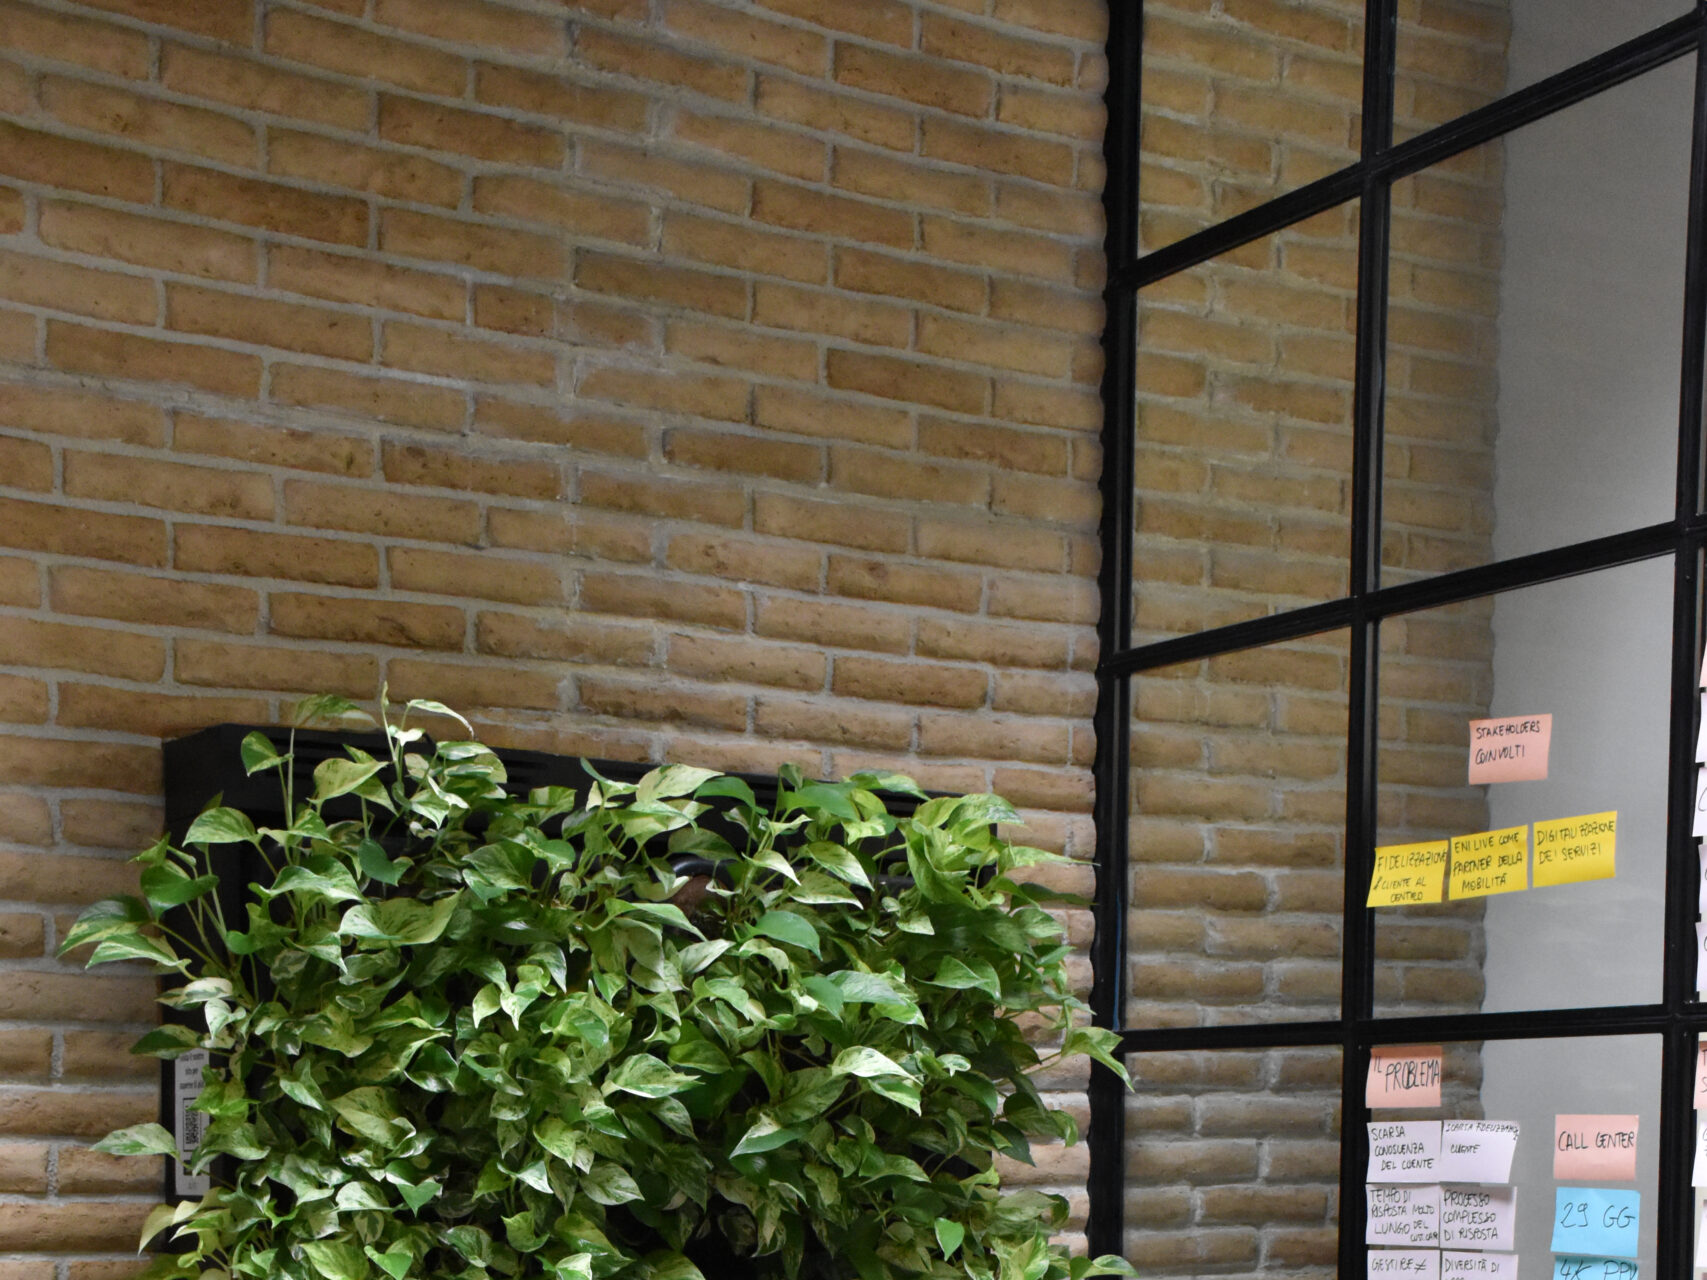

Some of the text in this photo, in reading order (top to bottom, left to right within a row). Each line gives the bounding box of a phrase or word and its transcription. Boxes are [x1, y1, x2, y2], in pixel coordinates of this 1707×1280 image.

[1476, 721, 1540, 740] STAKEHOLDERS
[1475, 745, 1525, 765] COINVOLTI
[1499, 832, 1520, 846] COME
[1453, 851, 1523, 876] PARTNER DELLA
[1416, 877, 1427, 887] AL
[1385, 1059, 1441, 1093] PROBLEMA
[1371, 1126, 1406, 1142] SCARSA
[1558, 1131, 1635, 1151] CALL CENTER
[1381, 1159, 1397, 1171] DEL
[1443, 1189, 1490, 1208] PROCESSO
[1442, 1210, 1497, 1224] COMPLESSO
[1560, 1202, 1636, 1228] 29 GG
[1375, 1222, 1410, 1235] LUNGO
[1443, 1229, 1454, 1241] DI
[1491, 1262, 1500, 1273] DI
